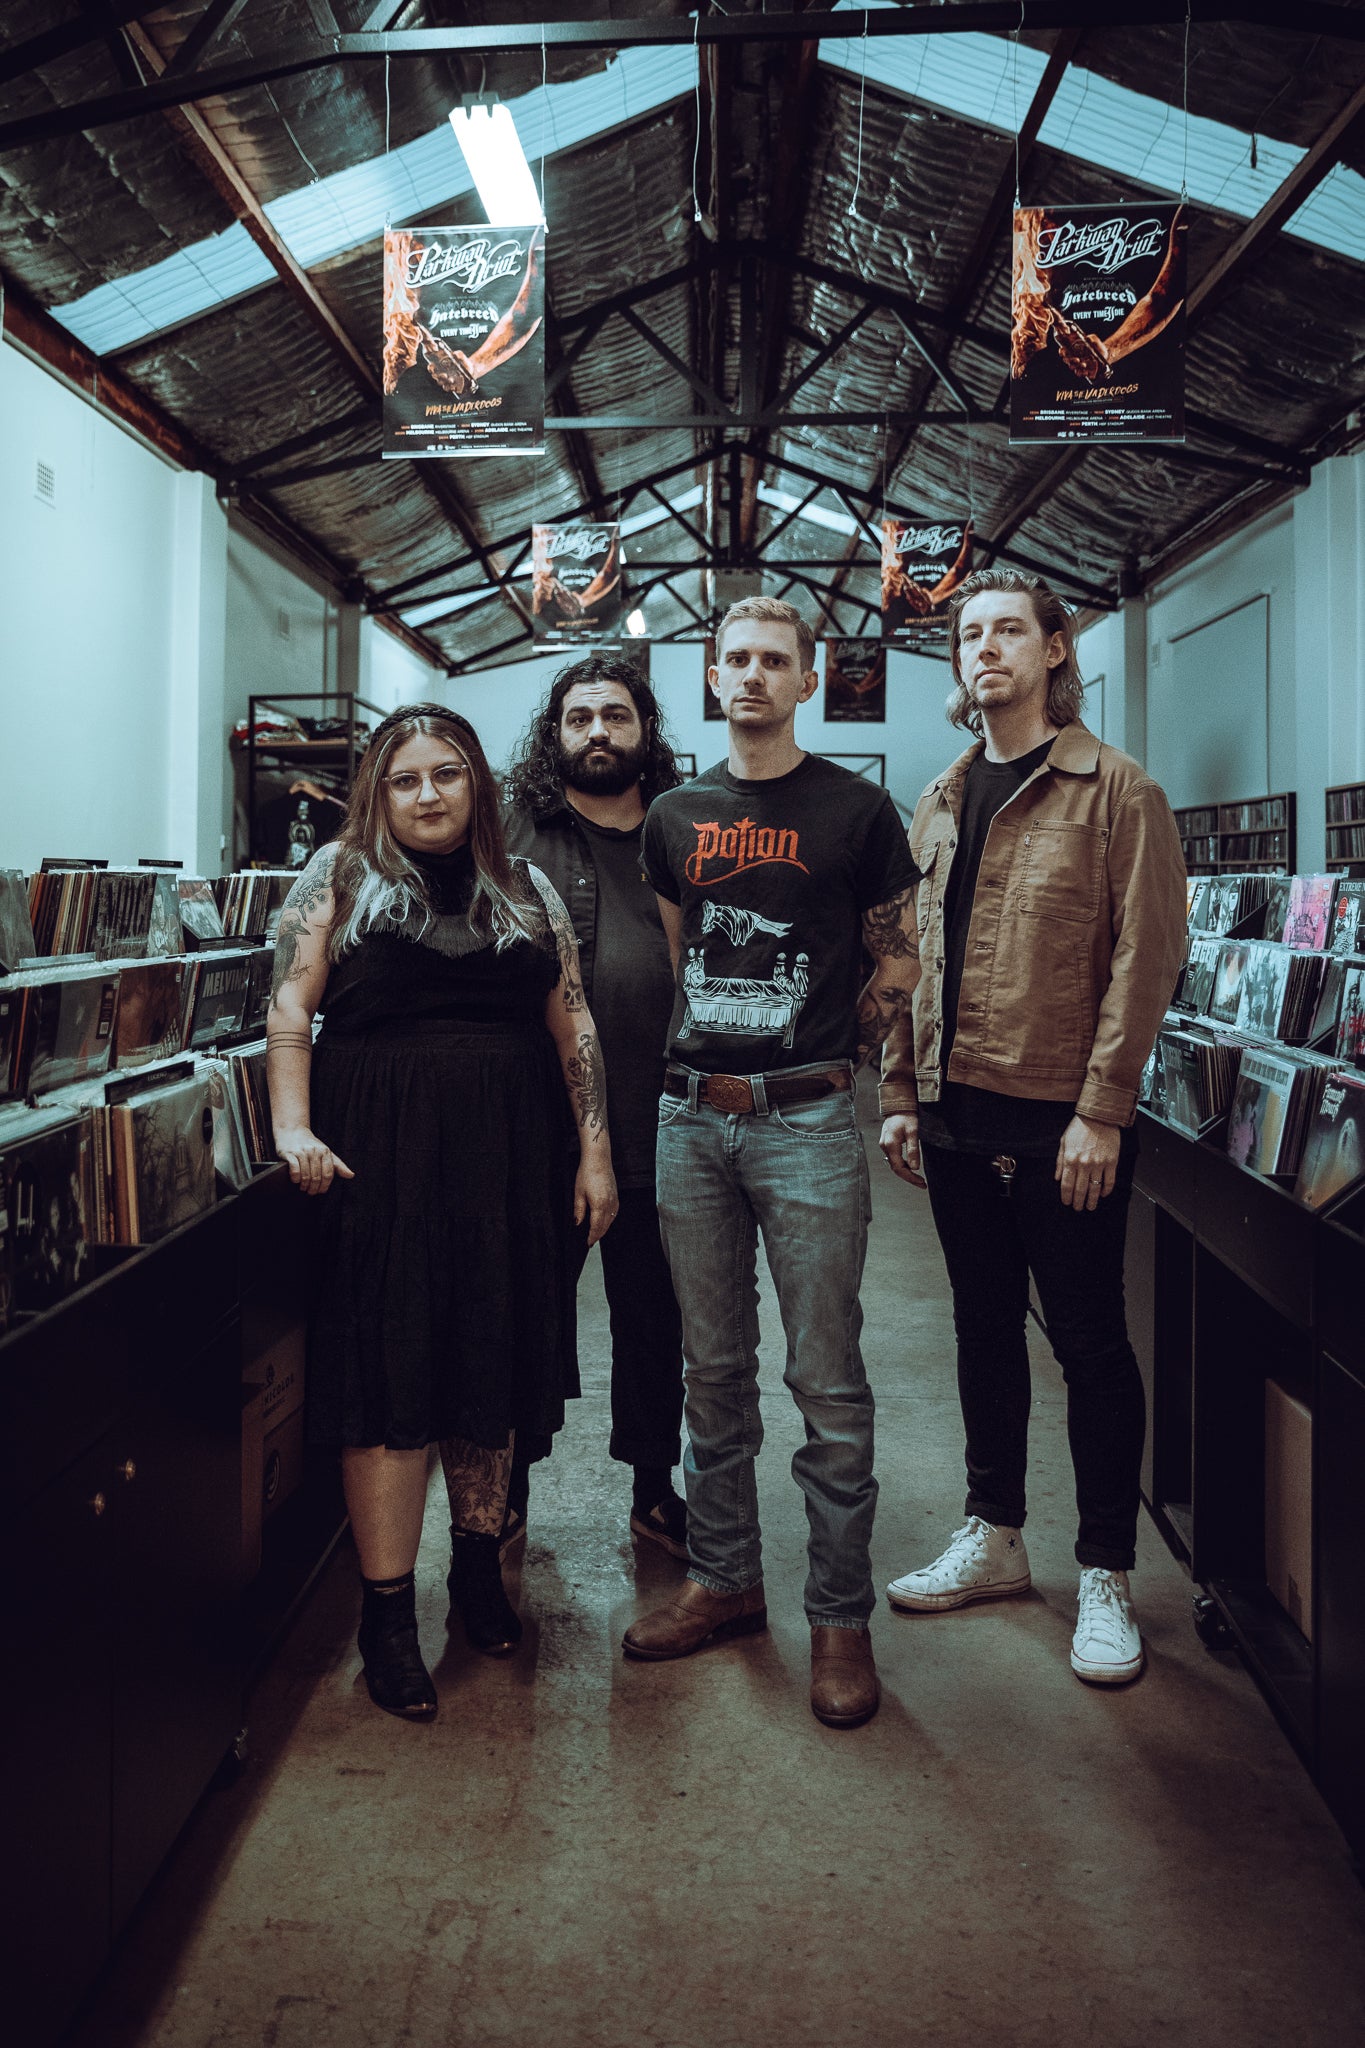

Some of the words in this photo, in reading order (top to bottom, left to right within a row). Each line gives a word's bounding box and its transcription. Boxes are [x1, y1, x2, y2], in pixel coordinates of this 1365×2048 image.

[1035, 218, 1129, 268] Parkway
[405, 239, 491, 288] Parkway
[1073, 311, 1092, 320] EVERY
[1093, 310, 1107, 319] TIME
[1114, 308, 1124, 316] DIE
[440, 328, 458, 338] EVERY
[1056, 390, 1073, 402] VIVA
[1084, 383, 1139, 400] UNDERDOGS
[425, 404, 441, 417] VIVA
[452, 397, 502, 414] UNDERDOGS
[686, 816, 809, 886] Potion
